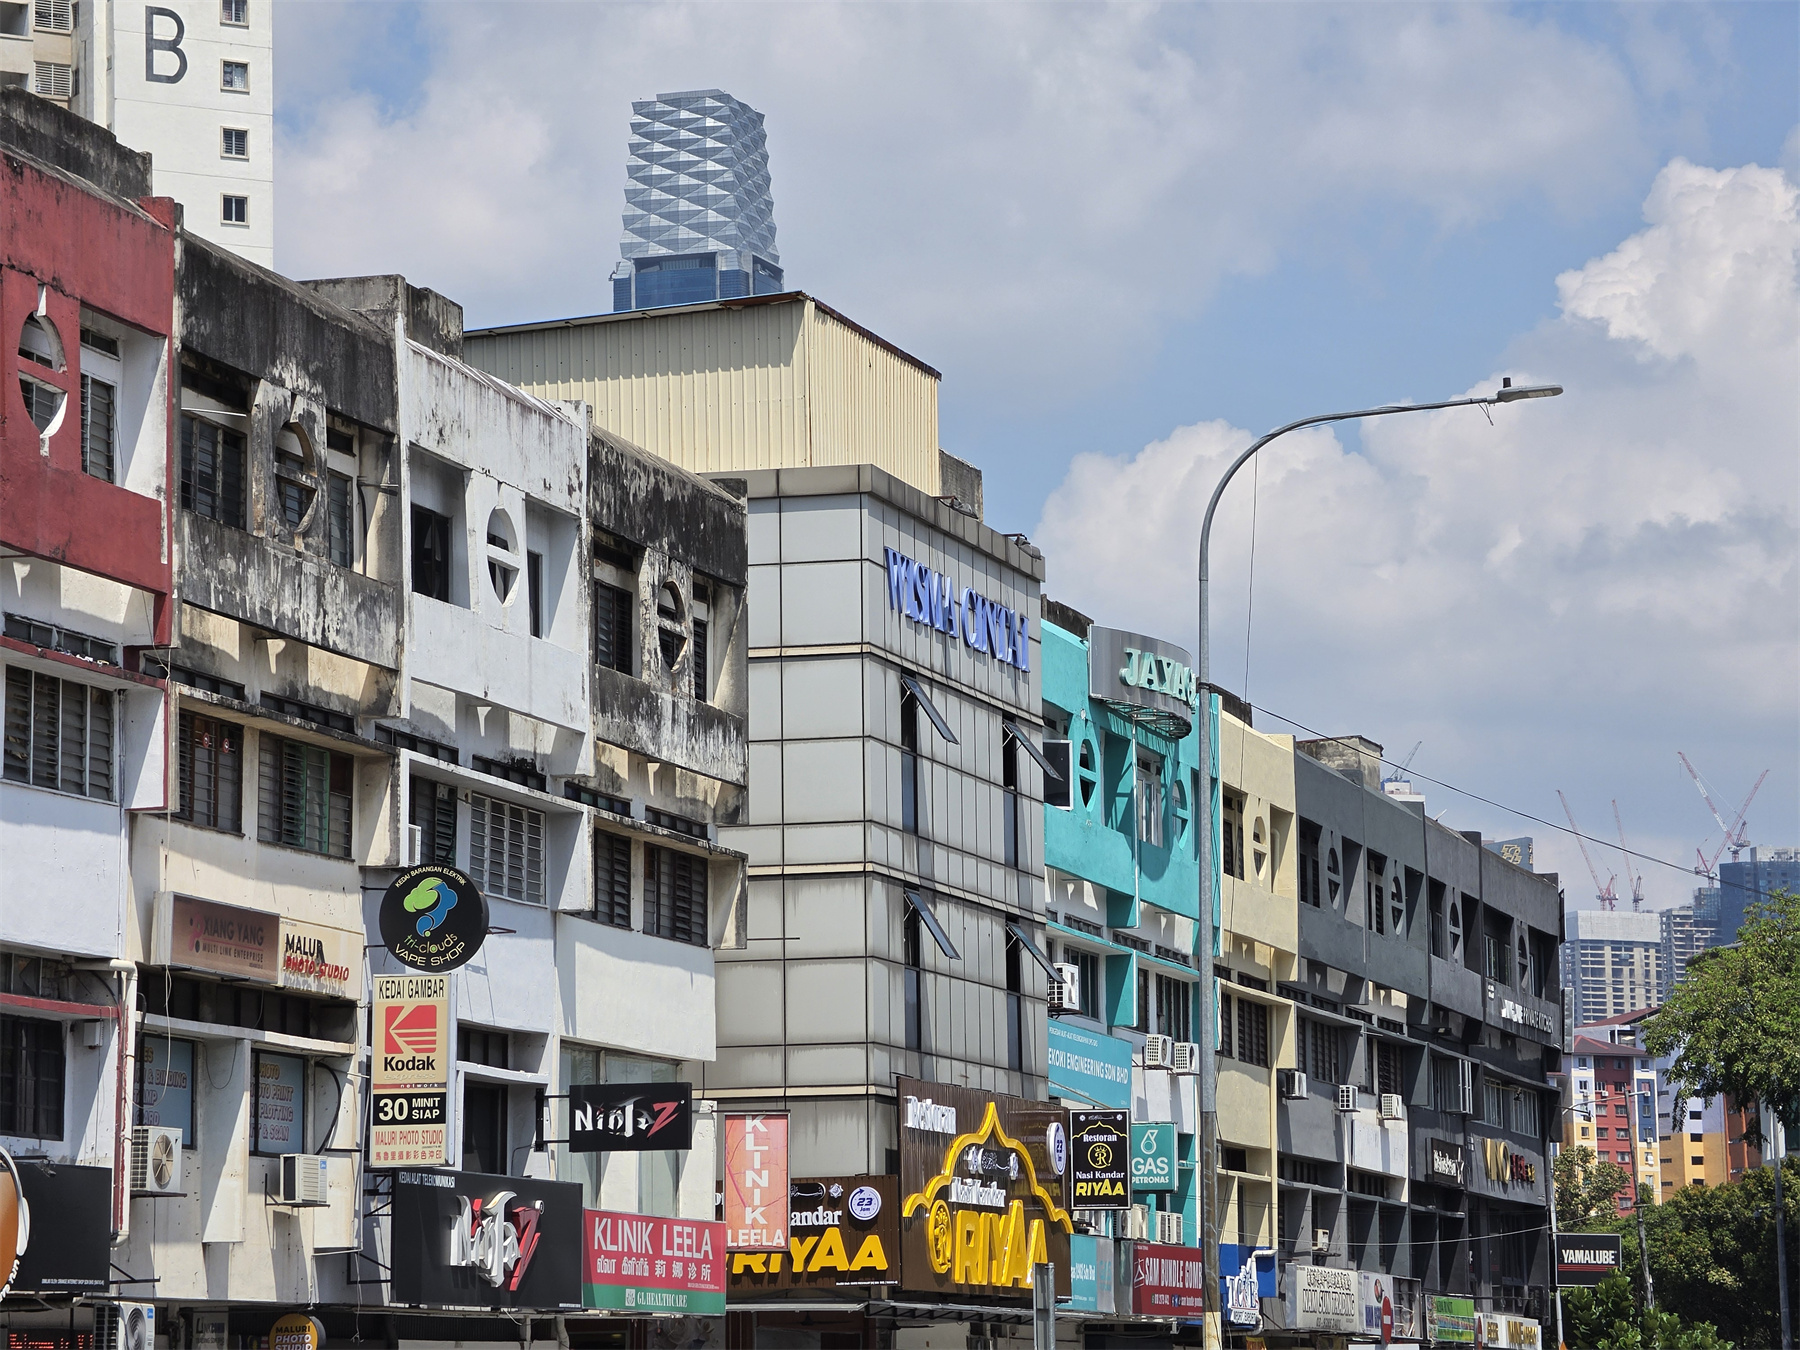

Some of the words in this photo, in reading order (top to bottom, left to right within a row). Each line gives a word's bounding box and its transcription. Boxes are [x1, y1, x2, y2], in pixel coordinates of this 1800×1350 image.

[145, 5, 188, 84] B
[884, 546, 959, 639] WISMA
[395, 874, 411, 888] KEDAI
[411, 866, 442, 877] BARANGAN
[443, 868, 467, 886] ELEKTRIK
[203, 917, 234, 942] XIANG
[237, 923, 264, 947] YANG
[202, 942, 218, 955] MULTI
[219, 945, 232, 957] LINK
[233, 947, 264, 963] ENTERPRISE
[404, 933, 458, 954] tri-clouds
[395, 944, 426, 966] VAPE
[431, 942, 465, 966] SHOP
[285, 956, 315, 975] PHOTO
[316, 963, 349, 981] STUDIO
[379, 980, 404, 999] KEDAI
[408, 979, 444, 998] GAMBAR
[384, 1056, 436, 1071] Kodak
[1067, 1053, 1104, 1078] ENGINEERING
[1105, 1063, 1116, 1082] SDN
[1117, 1067, 1129, 1085] BHD
[148, 1069, 154, 1084] &
[156, 1069, 187, 1088] BINDING
[272, 1084, 293, 1101] PRINT
[260, 1103, 293, 1122] PLOTTING
[378, 1098, 408, 1121] 30
[412, 1097, 440, 1108] MINIT
[412, 1109, 440, 1120] SIAP
[270, 1124, 289, 1141] SCAN
[375, 1131, 397, 1146] MALURI
[399, 1130, 419, 1145] PHOTO
[421, 1129, 443, 1145] STUDIO
[1083, 1134, 1117, 1142] Restoran
[745, 1115, 769, 1225] KLINIK
[1075, 1171, 1093, 1179] Nasi
[1095, 1171, 1125, 1179] Kandar
[1131, 1157, 1169, 1175] GAS
[422, 1174, 455, 1188] TELEKOMUNIKASI
[1075, 1179, 1125, 1196] RIYAA
[1132, 1176, 1169, 1184] PETRONAS
[856, 1197, 873, 1207] 23
[790, 1205, 842, 1227] andar
[594, 1217, 654, 1255] KLINIK
[662, 1224, 713, 1260] LEELA
[727, 1229, 785, 1247] LEELA
[1562, 1249, 1615, 1264] YAMALUBE
[1145, 1257, 1159, 1286] SAM
[1161, 1258, 1184, 1288] BUNDLE
[1185, 1261, 1203, 1289] GOMB
[637, 1292, 646, 1305] GL
[646, 1292, 687, 1307] HEALTHCARE
[1303, 1289, 1317, 1314] NAM
[1319, 1290, 1331, 1315] SUN
[1331, 1291, 1355, 1317] TRADING
[275, 1325, 311, 1333] MALURI
[275, 1334, 312, 1343] PHOTO
